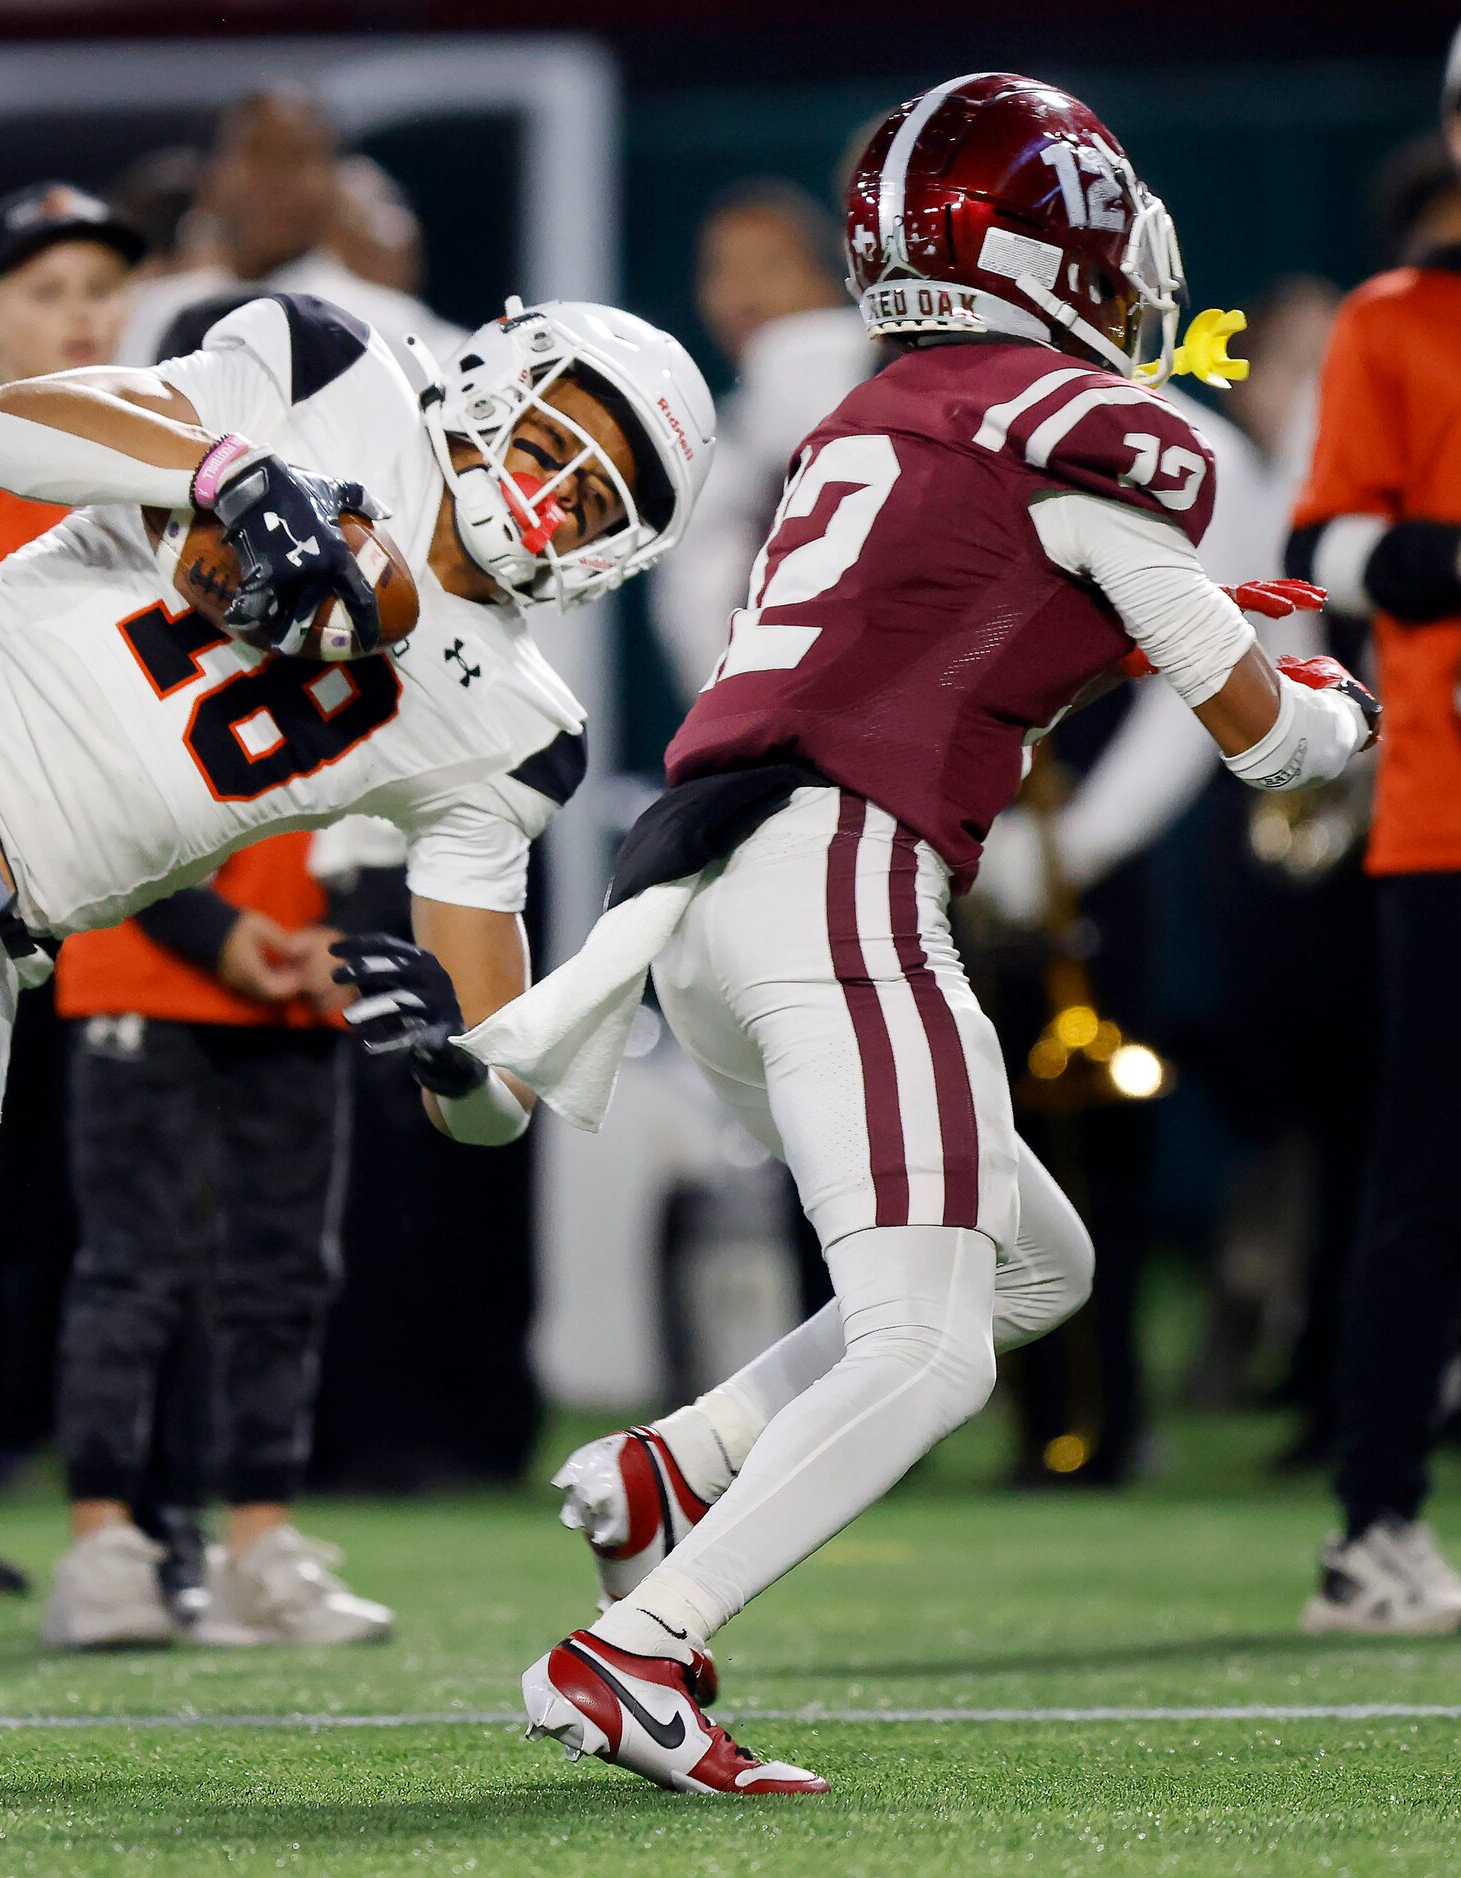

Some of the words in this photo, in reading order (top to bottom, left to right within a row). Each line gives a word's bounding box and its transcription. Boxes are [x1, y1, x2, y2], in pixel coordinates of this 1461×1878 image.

[1040, 140, 1126, 233] 12
[918, 289, 981, 321] OAK
[698, 434, 902, 693] 12
[116, 598, 403, 802] 18
